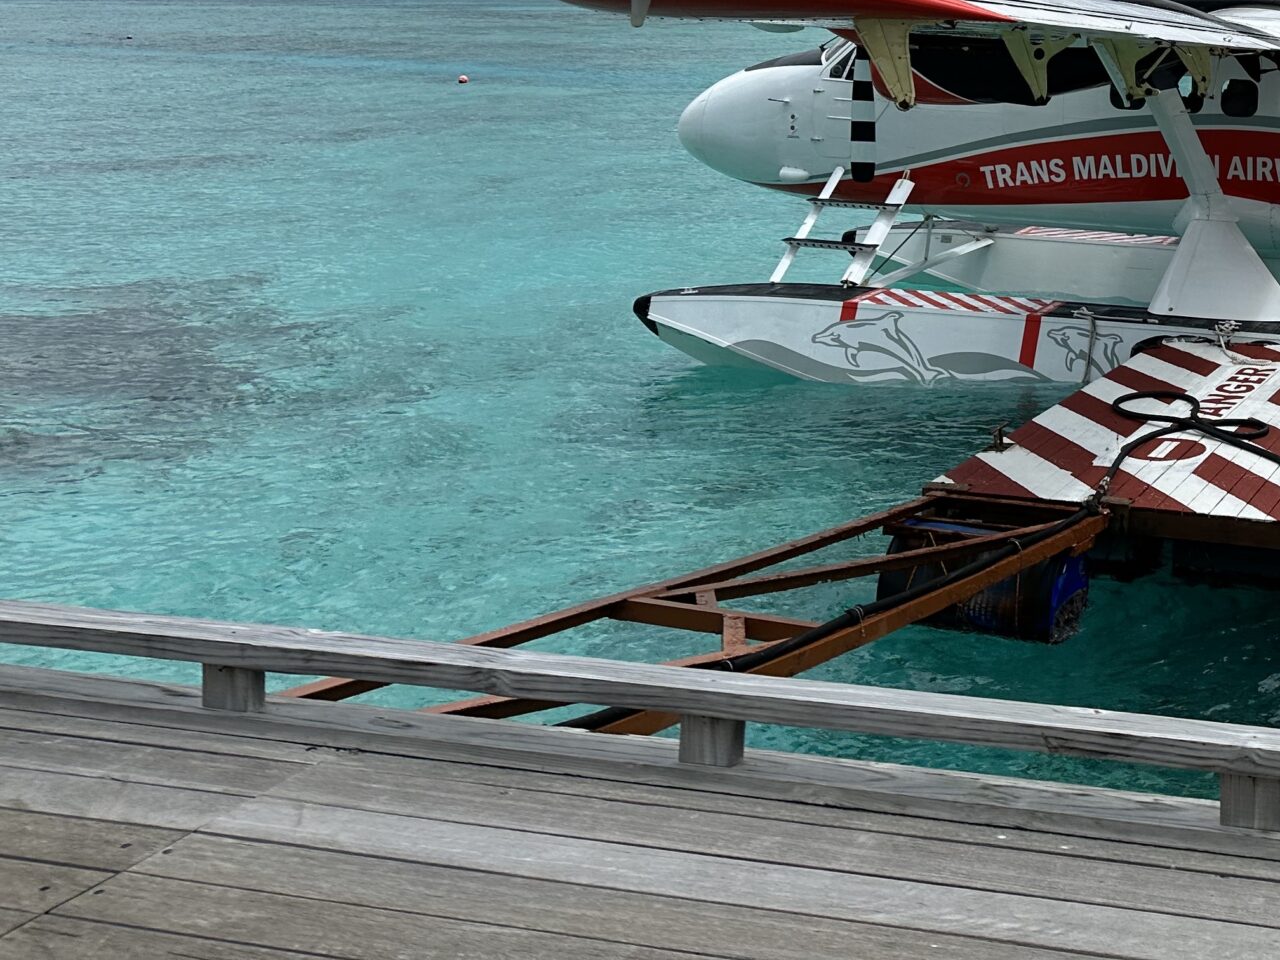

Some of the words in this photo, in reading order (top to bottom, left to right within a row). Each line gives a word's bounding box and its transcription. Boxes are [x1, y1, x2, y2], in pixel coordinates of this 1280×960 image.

[980, 158, 1066, 190] TRANS
[1072, 153, 1220, 181] MALDIVN
[1198, 366, 1278, 418] ANGER
